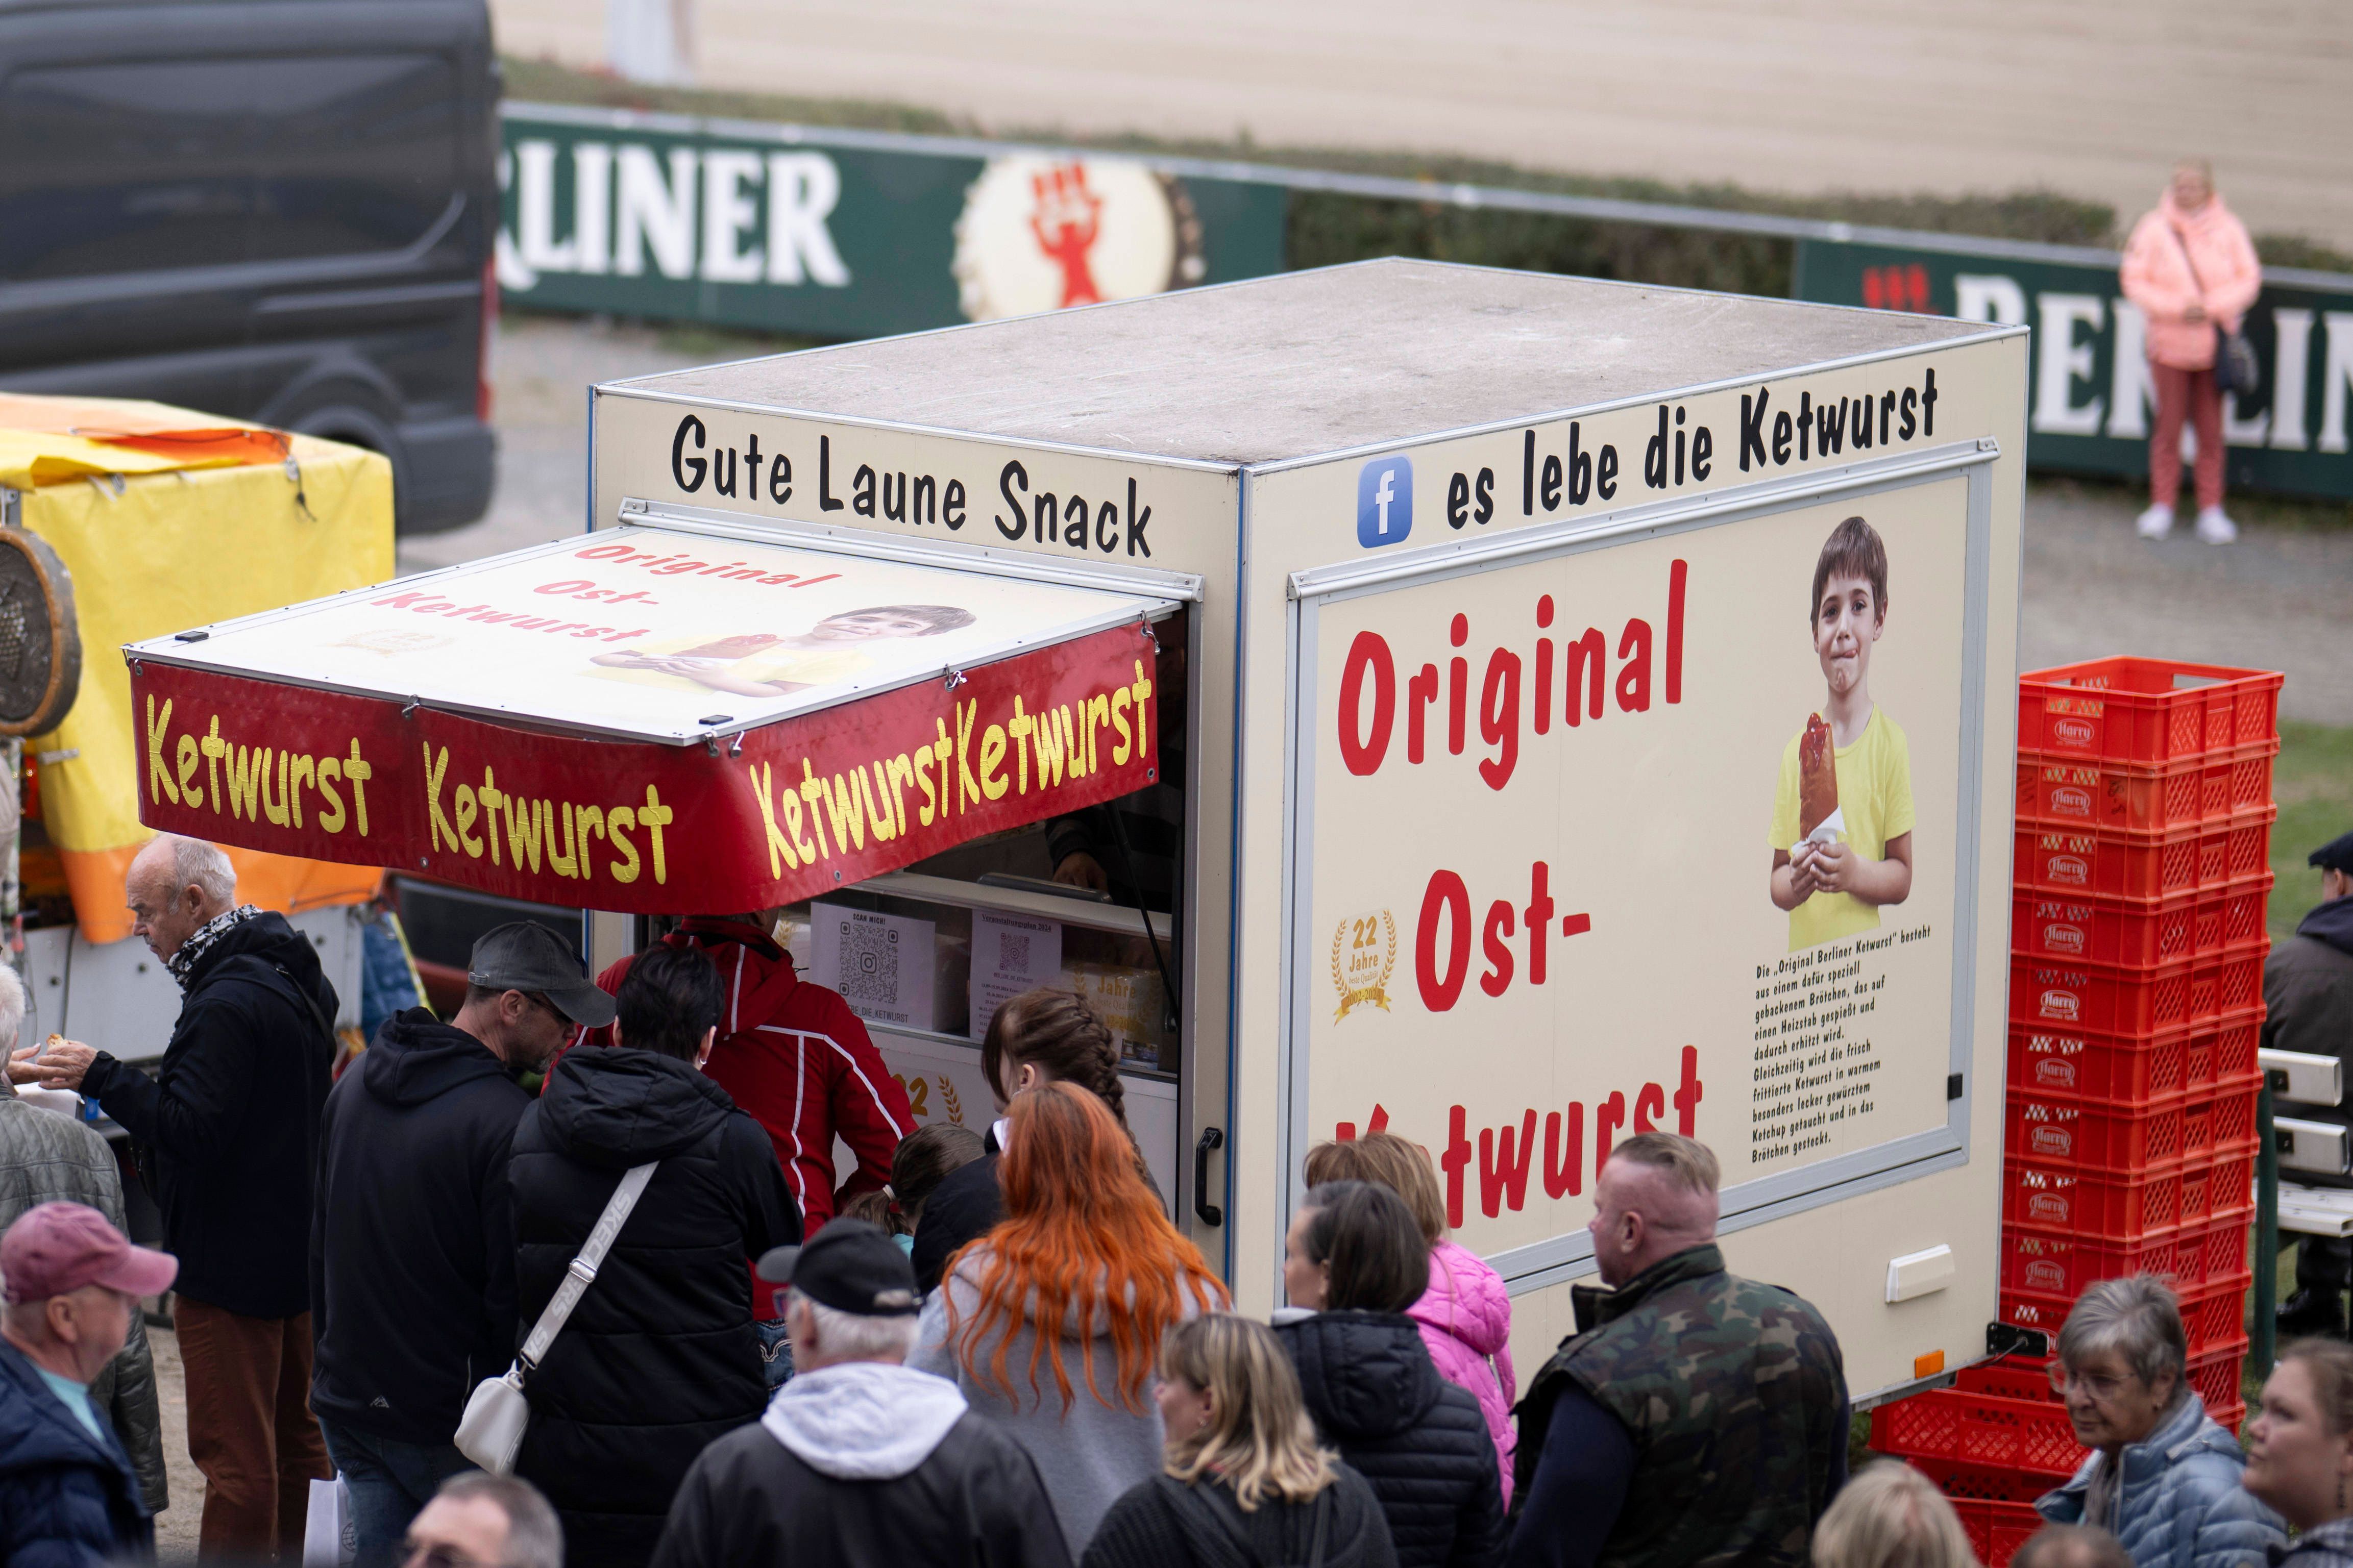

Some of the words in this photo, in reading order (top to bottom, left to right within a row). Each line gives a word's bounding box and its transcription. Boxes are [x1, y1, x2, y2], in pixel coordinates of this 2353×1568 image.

[1447, 466, 1494, 530] es
[1523, 421, 1619, 516] lebe
[1644, 404, 1712, 489] die
[1738, 367, 1939, 472] Ketwurst
[672, 414, 792, 505] Gute
[819, 435, 966, 531] Laune
[994, 459, 1152, 558] Snack
[574, 545, 843, 589] Original
[533, 580, 659, 608] Ost-
[369, 592, 652, 643] Ketwurst
[1337, 558, 1688, 791] Original
[2058, 721, 2091, 739] Harry
[146, 693, 372, 837] Ketwurst
[749, 717, 953, 880] Ketwurst
[956, 658, 1152, 815] Ketwurst
[423, 740, 673, 885] Ketwurst
[2055, 791, 2087, 809] Harry
[2052, 858, 2084, 876] Harry
[852, 913, 867, 922] SCAN
[869, 915, 886, 925] MICH!
[982, 913, 1037, 931] Veranstaltungsplan
[1037, 923, 1051, 932] 2024
[1353, 915, 1378, 950] 22
[1415, 860, 1591, 1012] Ost-
[2048, 926, 2080, 944] Harry
[1349, 951, 1378, 973] Jahre
[1756, 965, 1770, 979] Die
[1818, 945, 1852, 963] Berliner
[1900, 924, 1931, 944] besteht
[1097, 975, 1136, 999] Jahre
[1755, 999, 1805, 1024] gebackenem
[1809, 988, 1850, 1006] Brötchen,
[1854, 981, 1868, 994] das
[1871, 975, 1885, 990] auf
[1756, 989, 1769, 1000] aus
[1774, 980, 1798, 995] einem
[1802, 971, 1824, 988] dafür
[1828, 960, 1860, 984] speziell
[1755, 1026, 1777, 1041] einen
[1781, 1012, 1817, 1034] Heizstab
[1821, 1003, 1856, 1027] gespießt
[1860, 998, 1875, 1013] und
[2045, 992, 2075, 1011] Harry
[1754, 1041, 1787, 1061] dadurch
[1791, 1034, 1819, 1051] erhitzt
[1823, 1026, 1845, 1044] wird.
[1754, 1059, 1804, 1082] Gleichzeitig
[1808, 1050, 1826, 1068] wird
[1830, 1046, 1843, 1060] die
[1847, 1038, 1871, 1057] frisch
[1753, 1082, 1791, 1103] frittierte
[1795, 1072, 1832, 1091] Ketwurst
[1836, 1067, 1844, 1081] in
[1848, 1059, 1880, 1077] warmem
[2040, 1061, 2071, 1081] Harry
[1752, 1125, 1786, 1143] Ketchup
[1790, 1111, 1826, 1136] getaucht
[1830, 1106, 1845, 1122] und
[1848, 1104, 1856, 1116] in
[1860, 1100, 1874, 1113] das
[1753, 1102, 1794, 1123] besonders
[1798, 1093, 1823, 1111] lecker
[1827, 1082, 1870, 1106] gewürztem
[1336, 1044, 1703, 1229] twurst
[1752, 1143, 1789, 1163] Brötchen
[1793, 1131, 1831, 1156] gesteckt.
[2036, 1128, 2067, 1147] Harry
[2033, 1196, 2065, 1215] Harry
